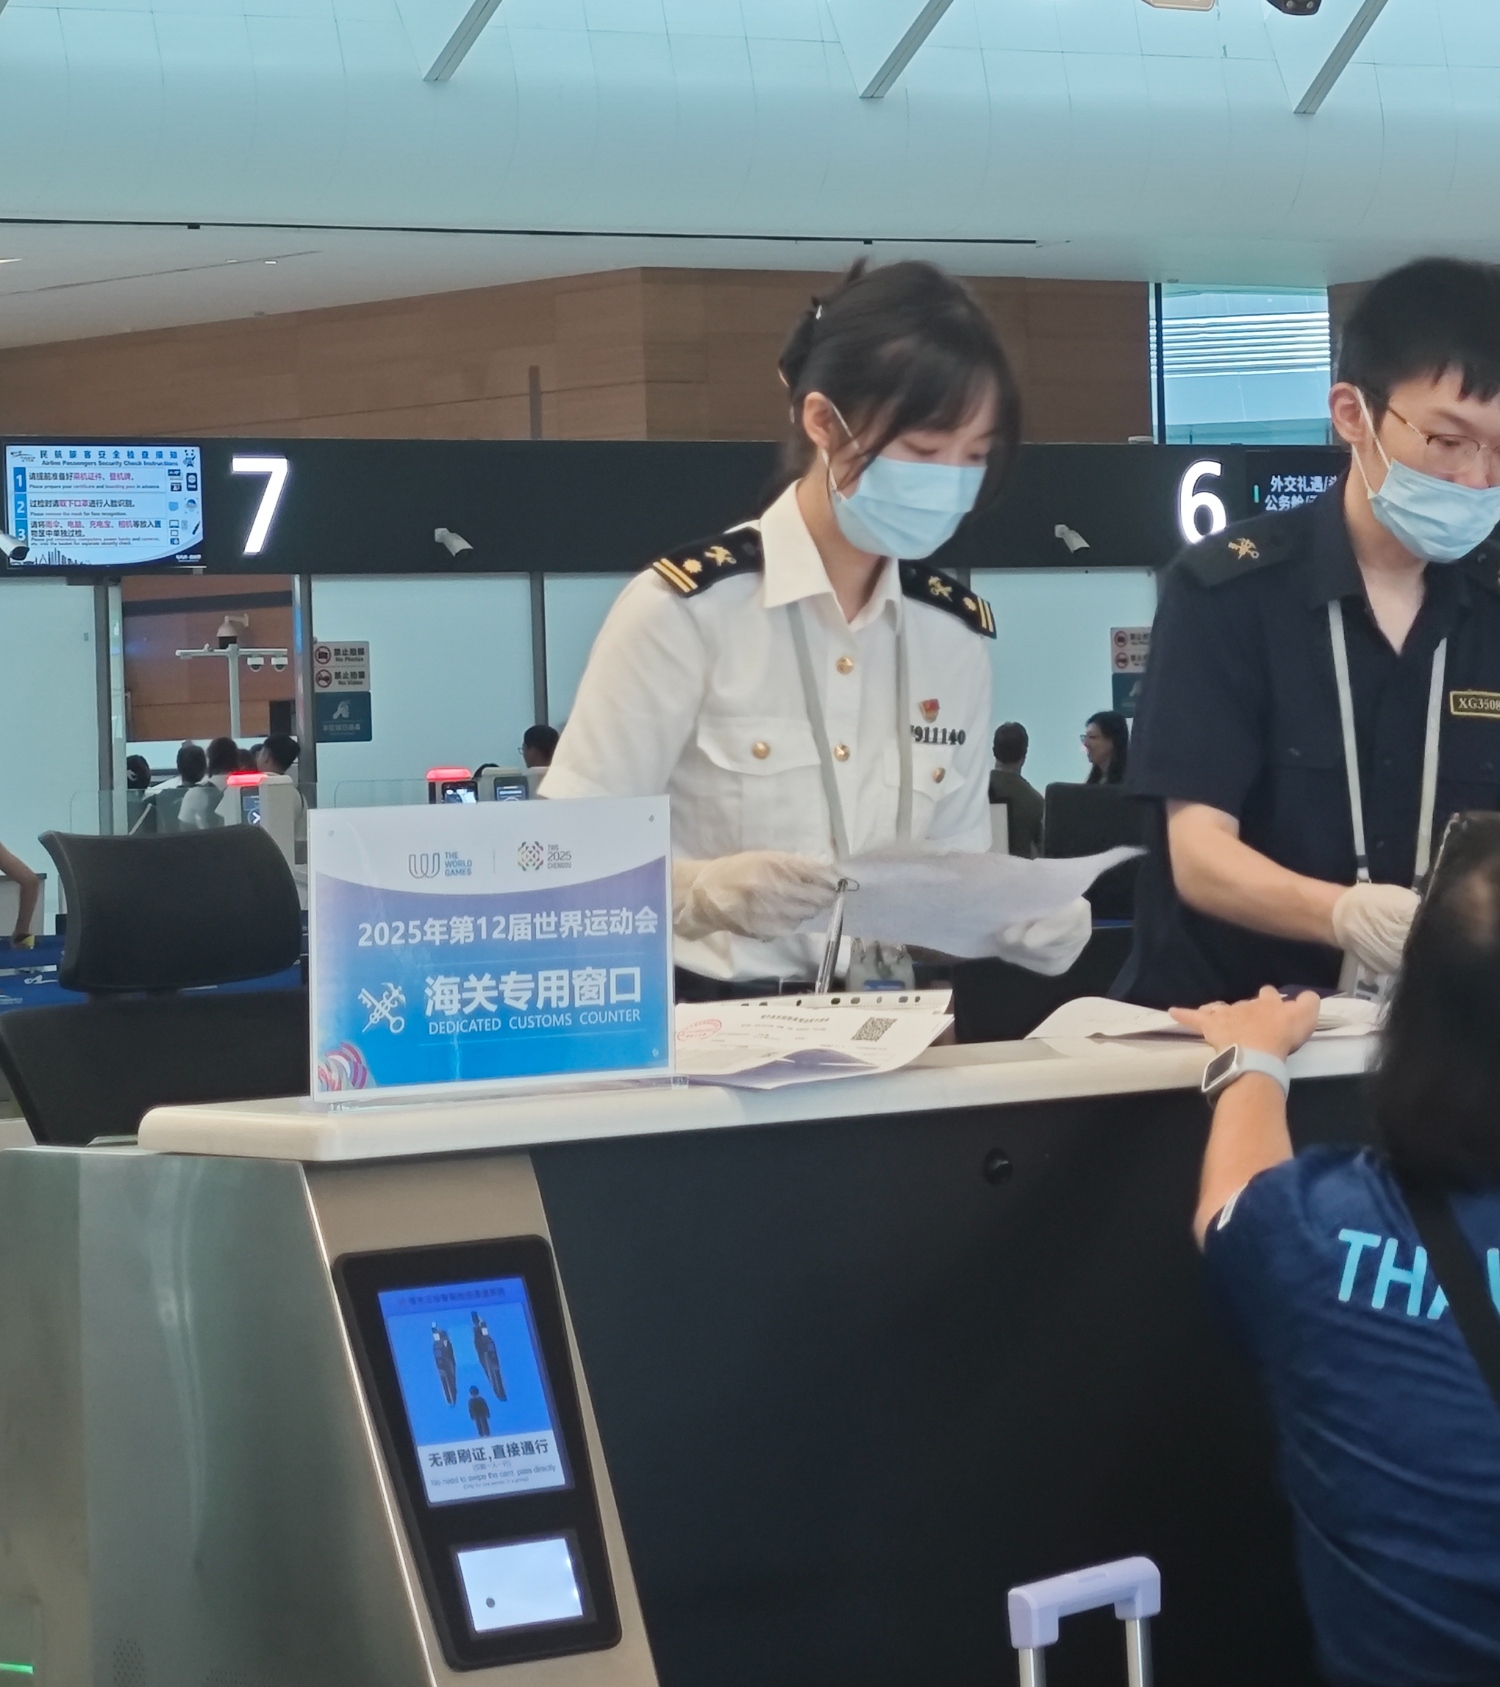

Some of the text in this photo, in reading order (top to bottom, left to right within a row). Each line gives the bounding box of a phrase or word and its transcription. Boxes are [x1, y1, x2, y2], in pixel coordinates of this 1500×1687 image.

[16, 474, 22, 488] 1
[17, 501, 25, 513] 2
[231, 456, 289, 555] 7
[1179, 459, 1227, 545] 6
[18, 528, 26, 541] 3
[444, 851, 459, 860] THE
[547, 851, 572, 862] 2025
[444, 859, 473, 868] WORLD
[444, 868, 472, 877] GAMES
[357, 905, 659, 947] 2025年第12届世界运动会
[424, 966, 642, 1017] 海关专用窗口
[428, 1008, 641, 1035] DEDICATED CUSTOMS COUNTER
